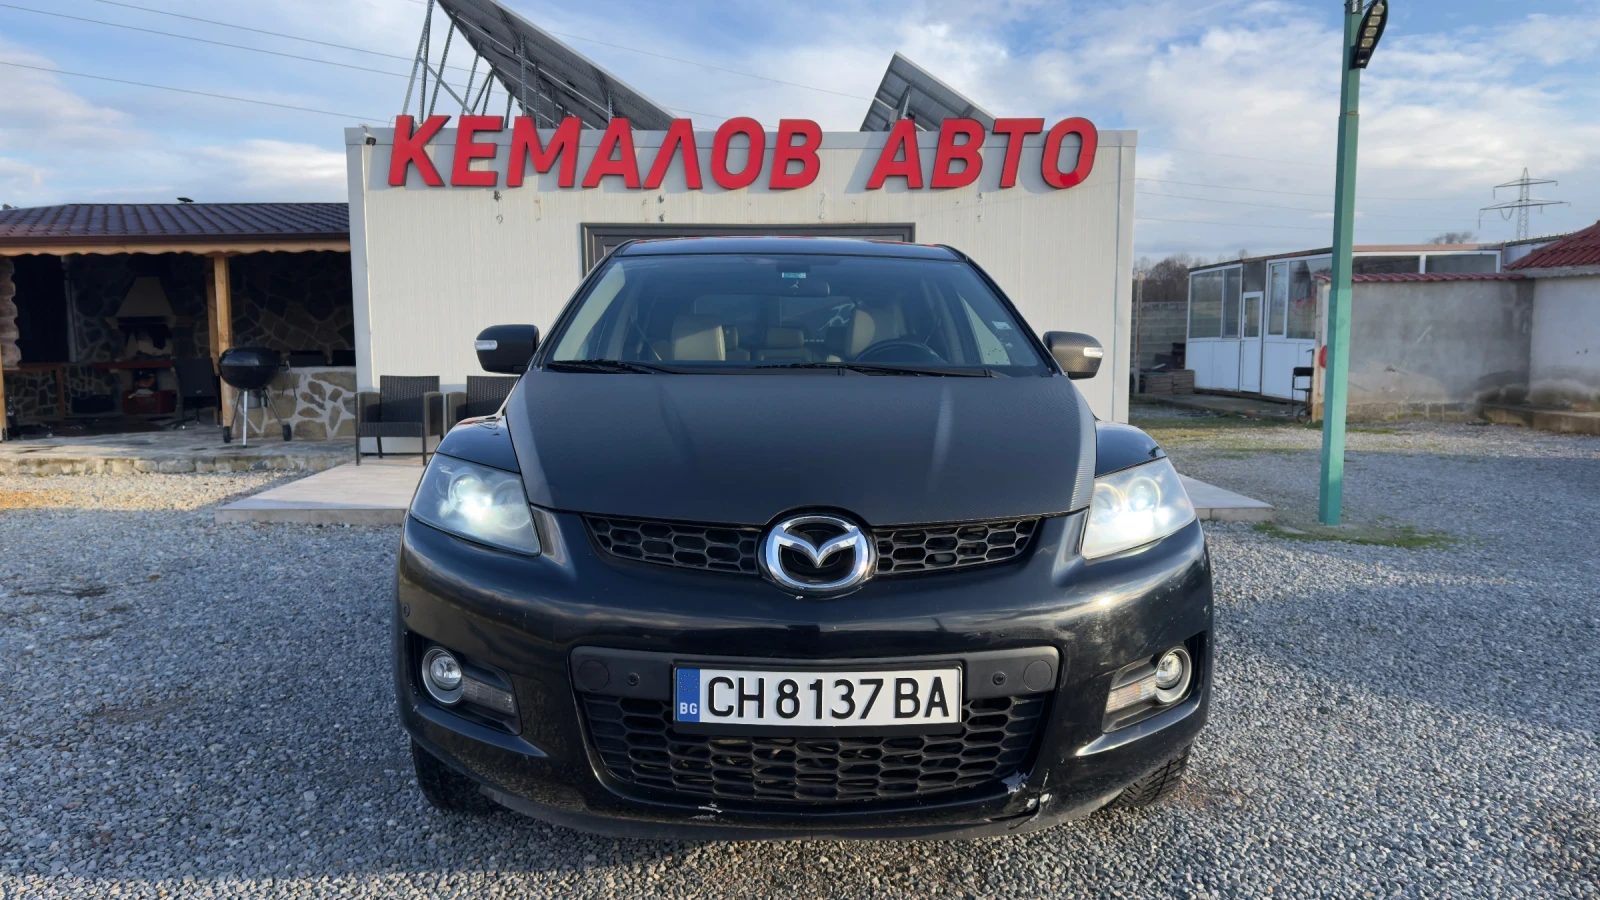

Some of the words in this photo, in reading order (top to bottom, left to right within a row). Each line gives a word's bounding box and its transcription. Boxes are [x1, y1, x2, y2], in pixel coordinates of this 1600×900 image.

[387, 114, 823, 190] КЕМАЛОВ
[865, 116, 1099, 190] АВТО
[679, 702, 698, 715] BG
[707, 676, 765, 718] CH
[776, 678, 884, 720] 8137
[894, 676, 950, 719] BA
